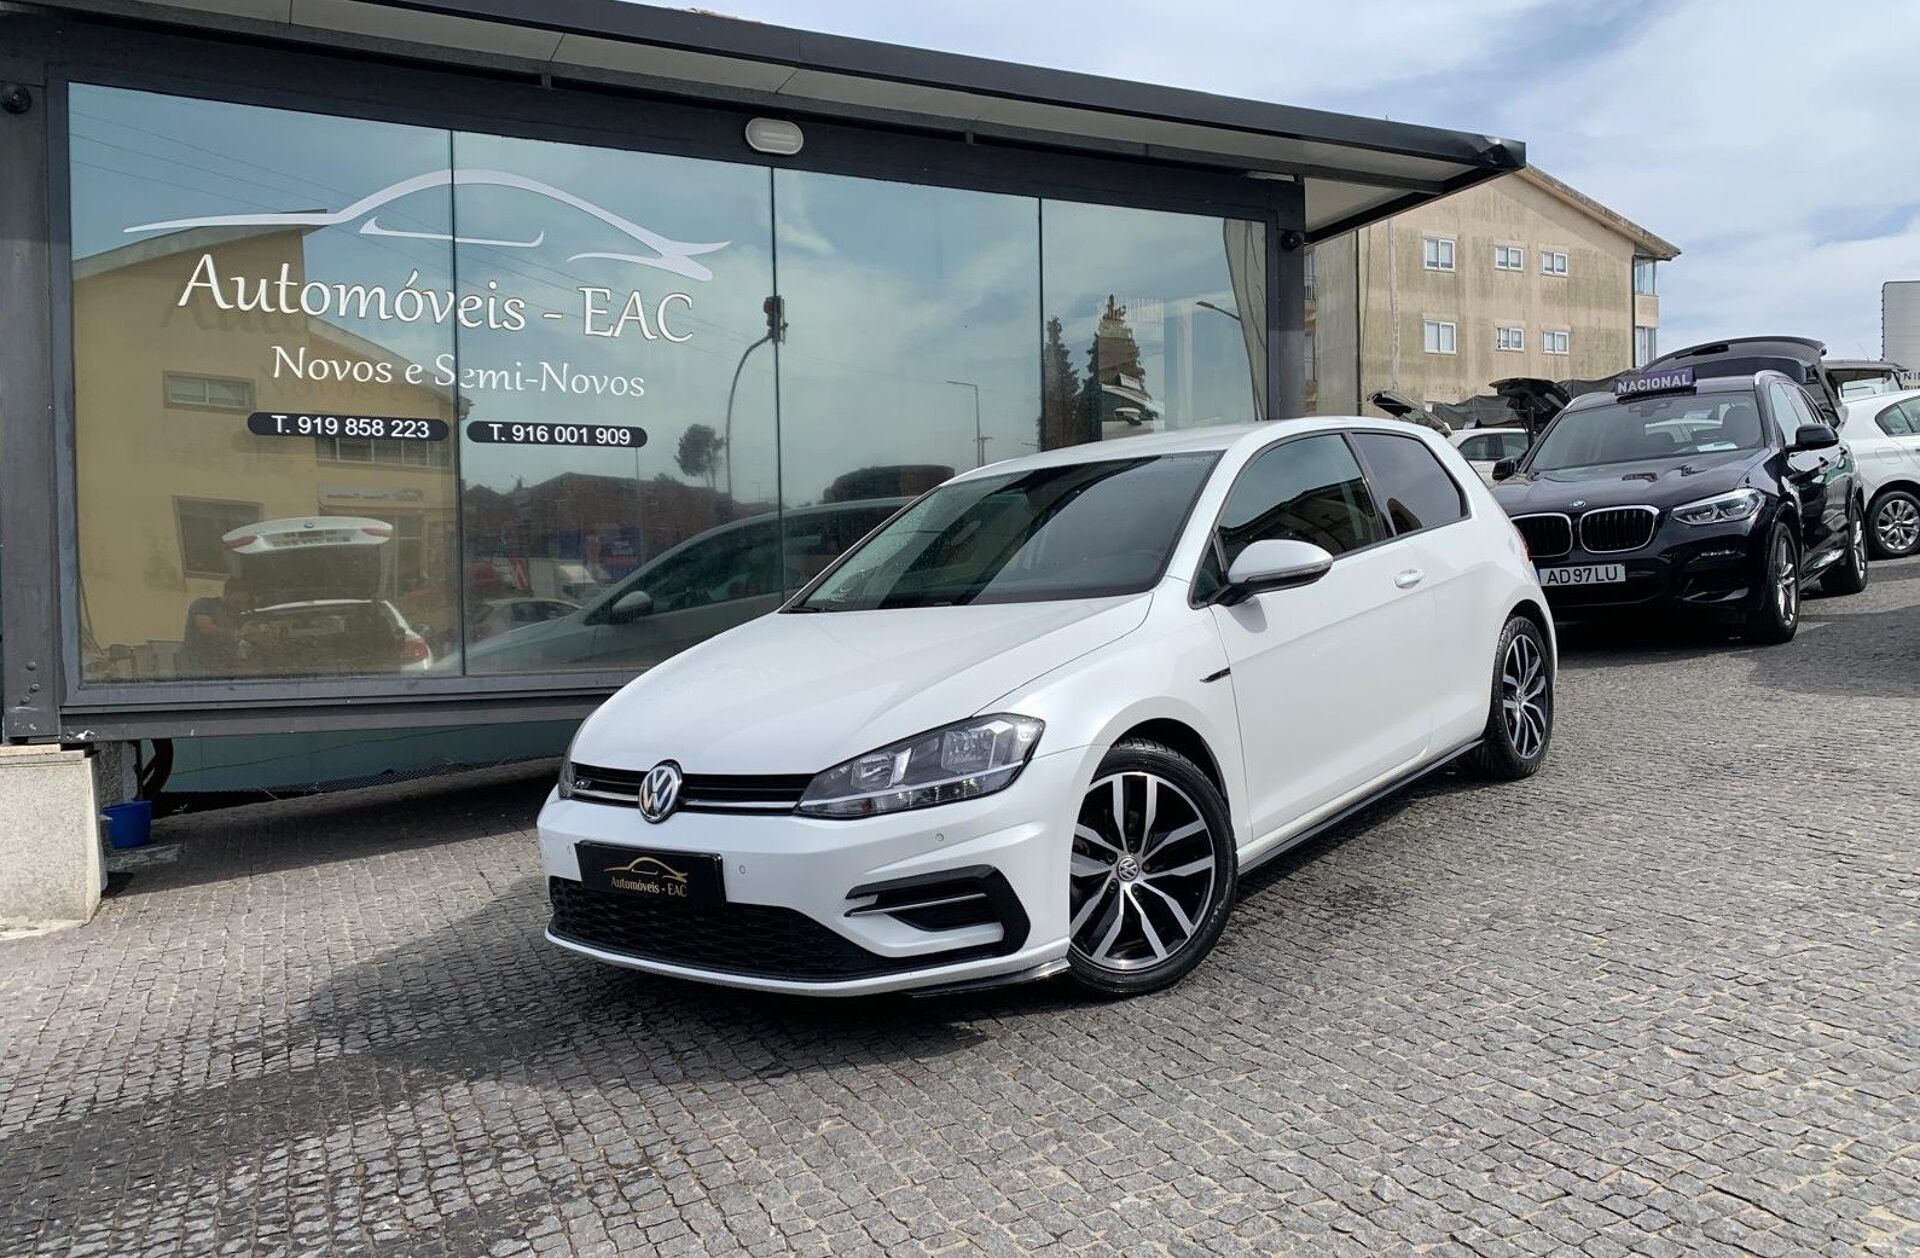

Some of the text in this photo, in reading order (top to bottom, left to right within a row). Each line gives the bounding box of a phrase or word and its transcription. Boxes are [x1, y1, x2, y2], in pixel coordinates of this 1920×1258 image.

[178, 253, 526, 331] Automóveis
[577, 287, 694, 343] EAC
[271, 345, 646, 397] Novos e Semi-Novos
[1616, 374, 1692, 394] NACIONAL
[271, 414, 430, 438] T. 919 858 223
[488, 423, 631, 445] T. 916 001 909
[610, 874, 660, 894] Automóveis
[667, 882, 688, 898] EAC
